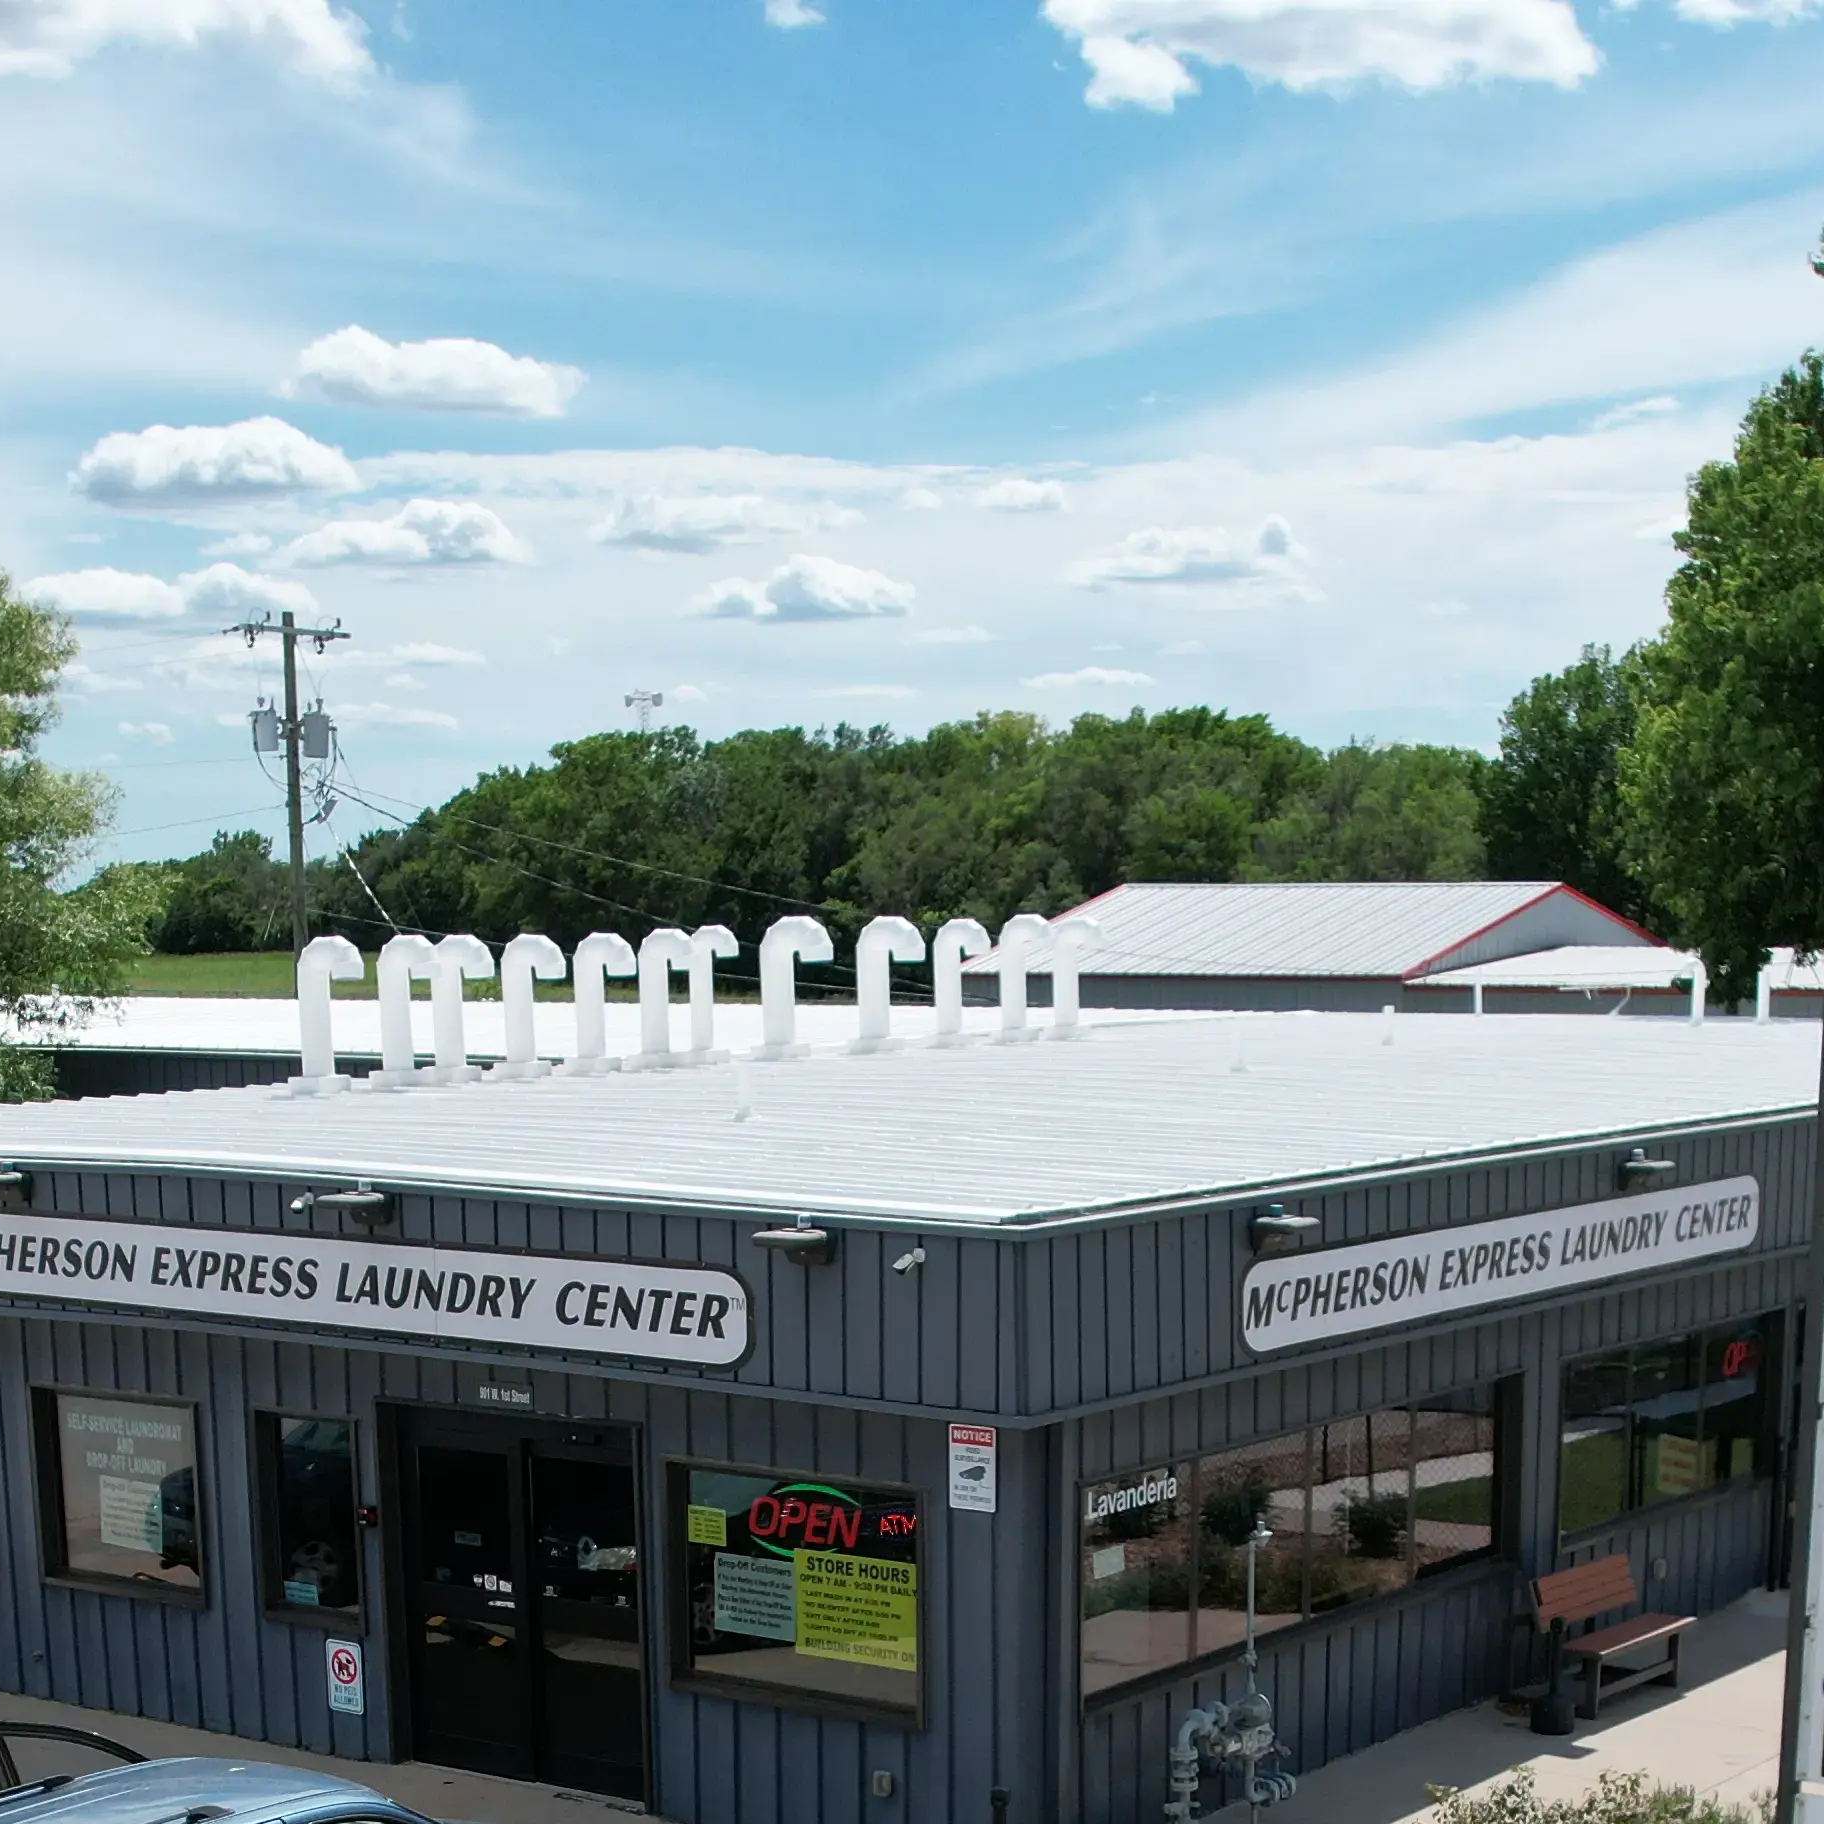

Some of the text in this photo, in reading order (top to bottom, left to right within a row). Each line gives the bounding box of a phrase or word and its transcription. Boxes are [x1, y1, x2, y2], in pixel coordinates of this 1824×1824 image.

[1439, 1230, 1552, 1290] EXPRESS
[1559, 1210, 1669, 1266] LAUNDRY
[150, 1246, 319, 1300] EXPRESS
[336, 1261, 536, 1319] LAUNDRY
[479, 1386, 490, 1400] 901
[501, 1388, 511, 1402] 1st
[511, 1389, 530, 1404] Street
[67, 1412, 183, 1442] SELF-SERVICE LAUNDROMAT
[952, 1429, 992, 1443] NOTICE
[116, 1437, 134, 1455] AND
[86, 1451, 167, 1477] DROP-OFF LAUNDRY
[1087, 1471, 1177, 1519] Lavandería
[748, 1496, 862, 1548] OPEN
[879, 1514, 917, 1536] ATM
[807, 1556, 910, 1584] STORE HOURS
[799, 1573, 823, 1585] OPEN
[833, 1578, 847, 1588] AM
[875, 1583, 889, 1594] PM
[891, 1586, 917, 1597] DAILY
[805, 1637, 851, 1654] BUILDING
[853, 1644, 899, 1660] SECURITY
[334, 1683, 342, 1694] NO
